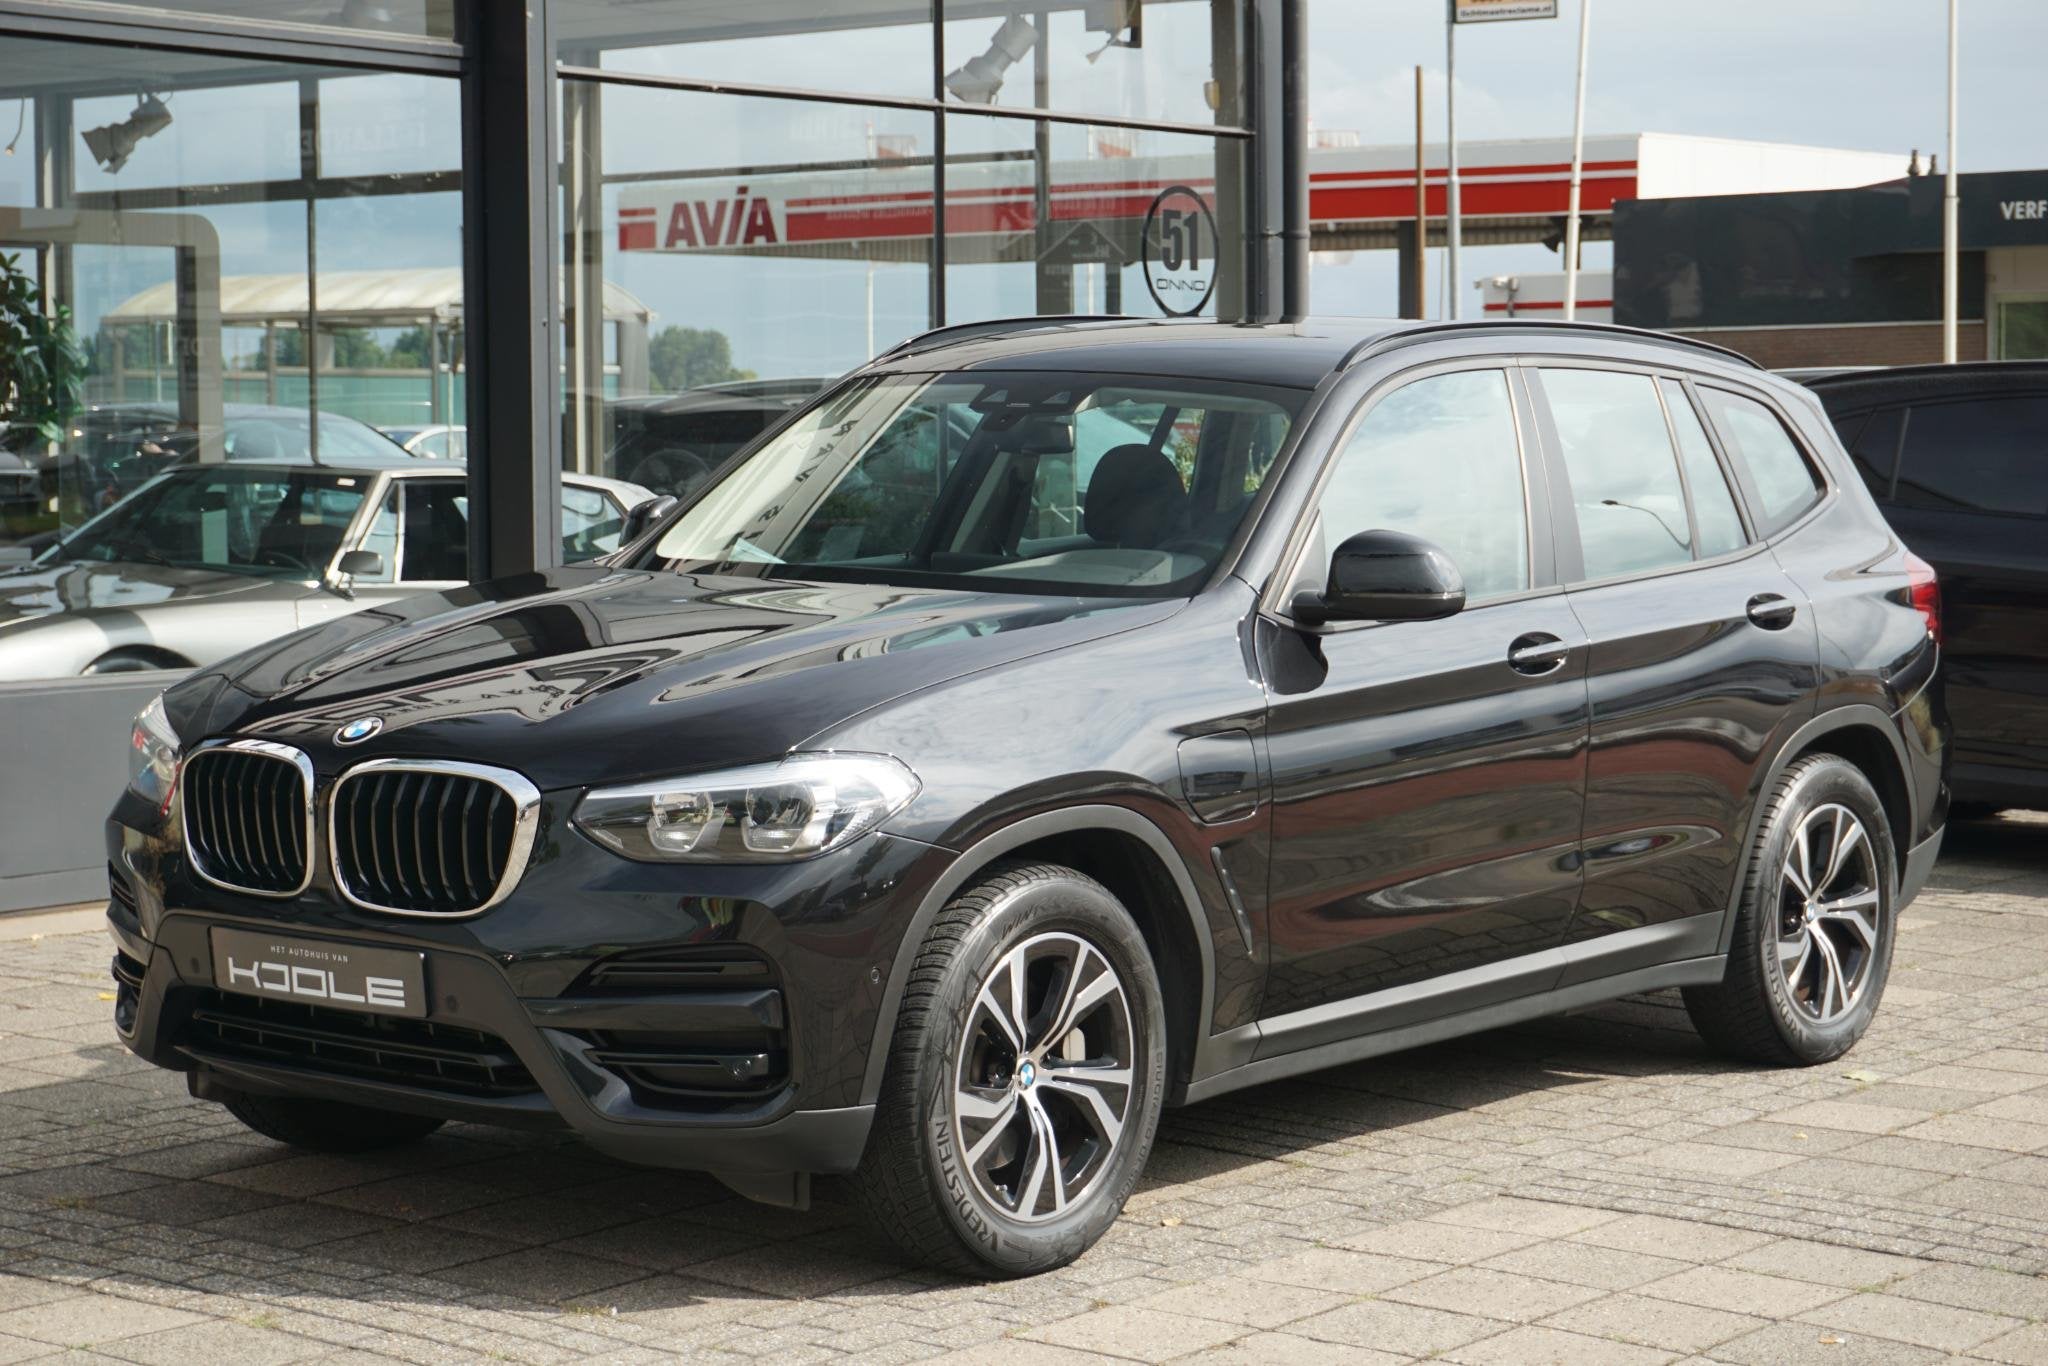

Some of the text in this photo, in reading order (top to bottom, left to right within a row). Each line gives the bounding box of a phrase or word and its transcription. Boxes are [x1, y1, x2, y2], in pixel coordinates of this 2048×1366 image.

[1162, 209, 1198, 271] 51
[1156, 278, 1206, 291] ONNO
[270, 945, 349, 963] HET AUTOHUIS VAN
[228, 957, 406, 1008] KOOLE
[935, 1121, 999, 1252] VREDESTEIN
